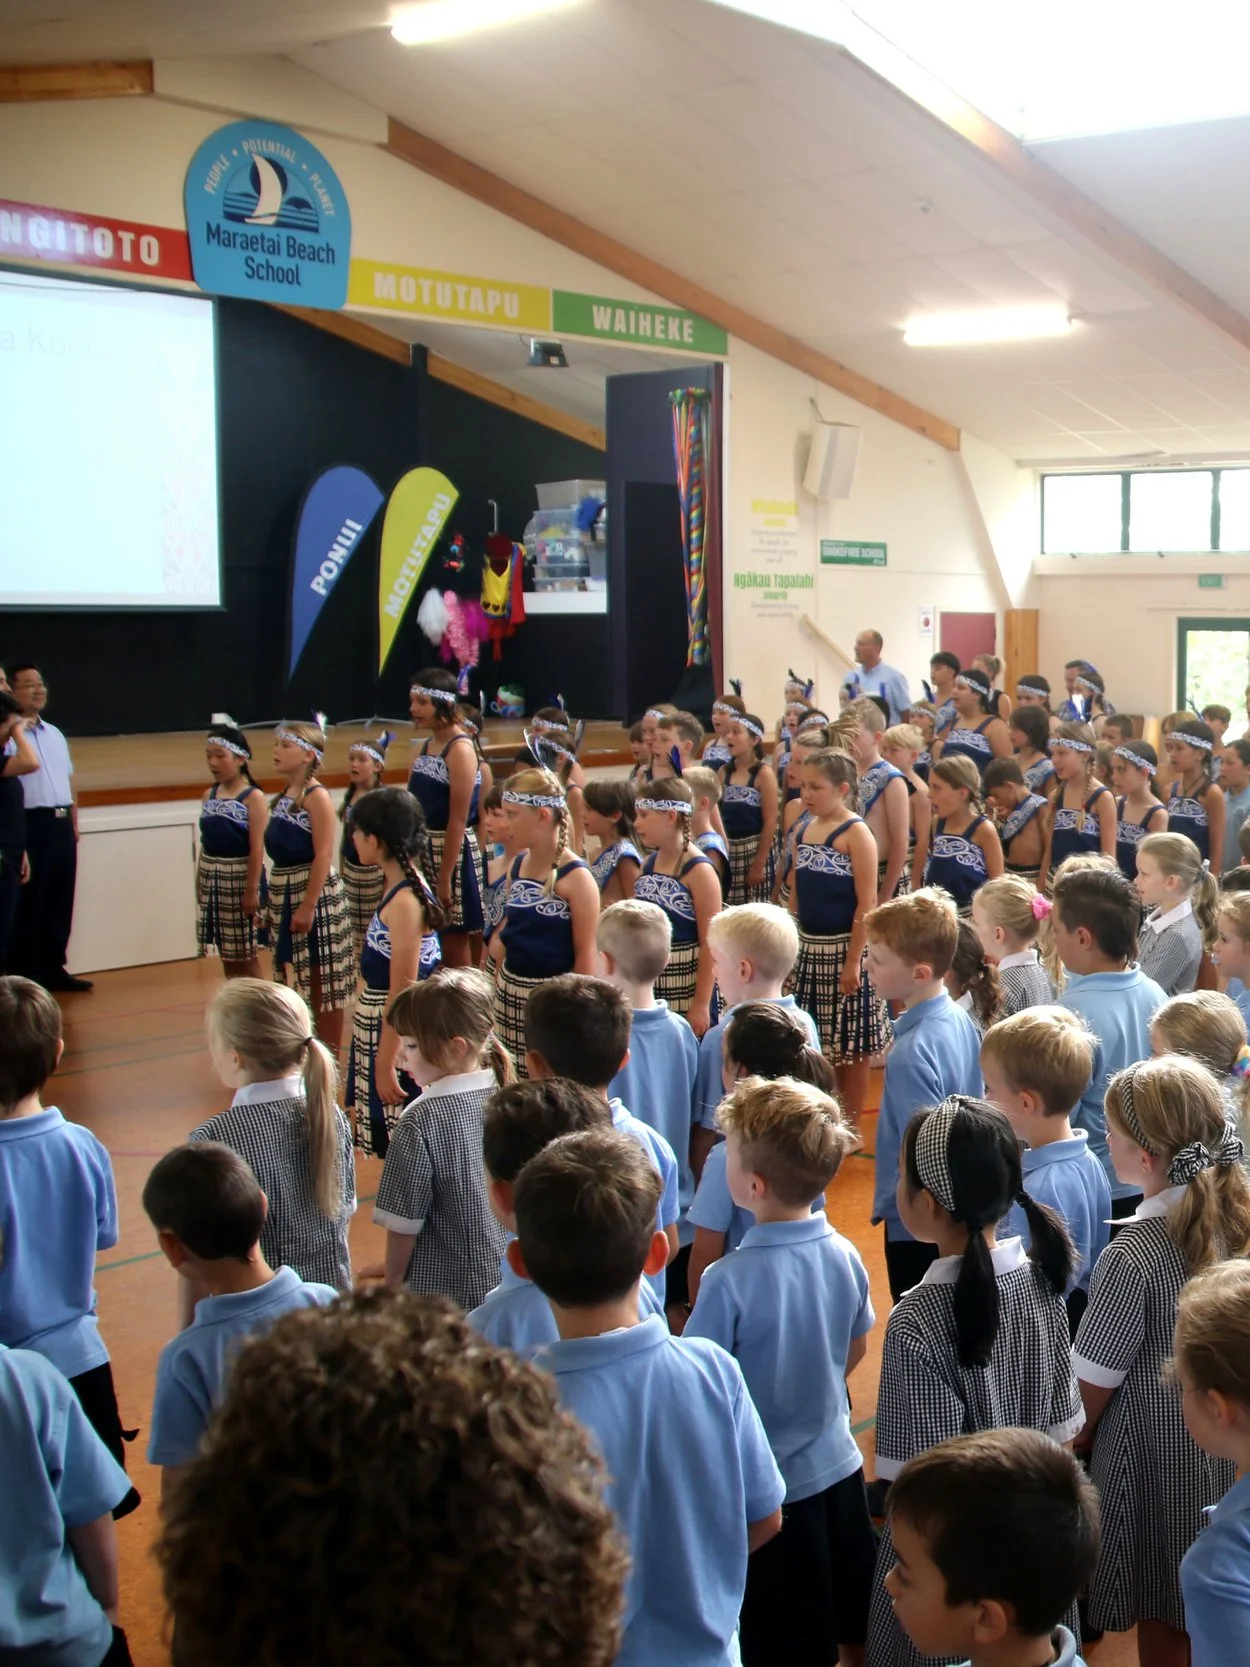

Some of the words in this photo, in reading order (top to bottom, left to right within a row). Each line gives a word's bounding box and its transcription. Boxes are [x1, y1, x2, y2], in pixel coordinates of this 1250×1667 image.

[204, 153, 231, 195] PEOPLE
[241, 139, 298, 165] POTENTIAL
[309, 173, 336, 216] PLANET
[206, 221, 281, 256] Maraetai
[286, 235, 336, 265] Beach
[244, 256, 302, 286] School
[373, 271, 520, 319] MOTUTAPU
[592, 304, 694, 344] WAIHEKE
[310, 518, 363, 596] PONUI
[384, 492, 451, 619] MOTUTAPU
